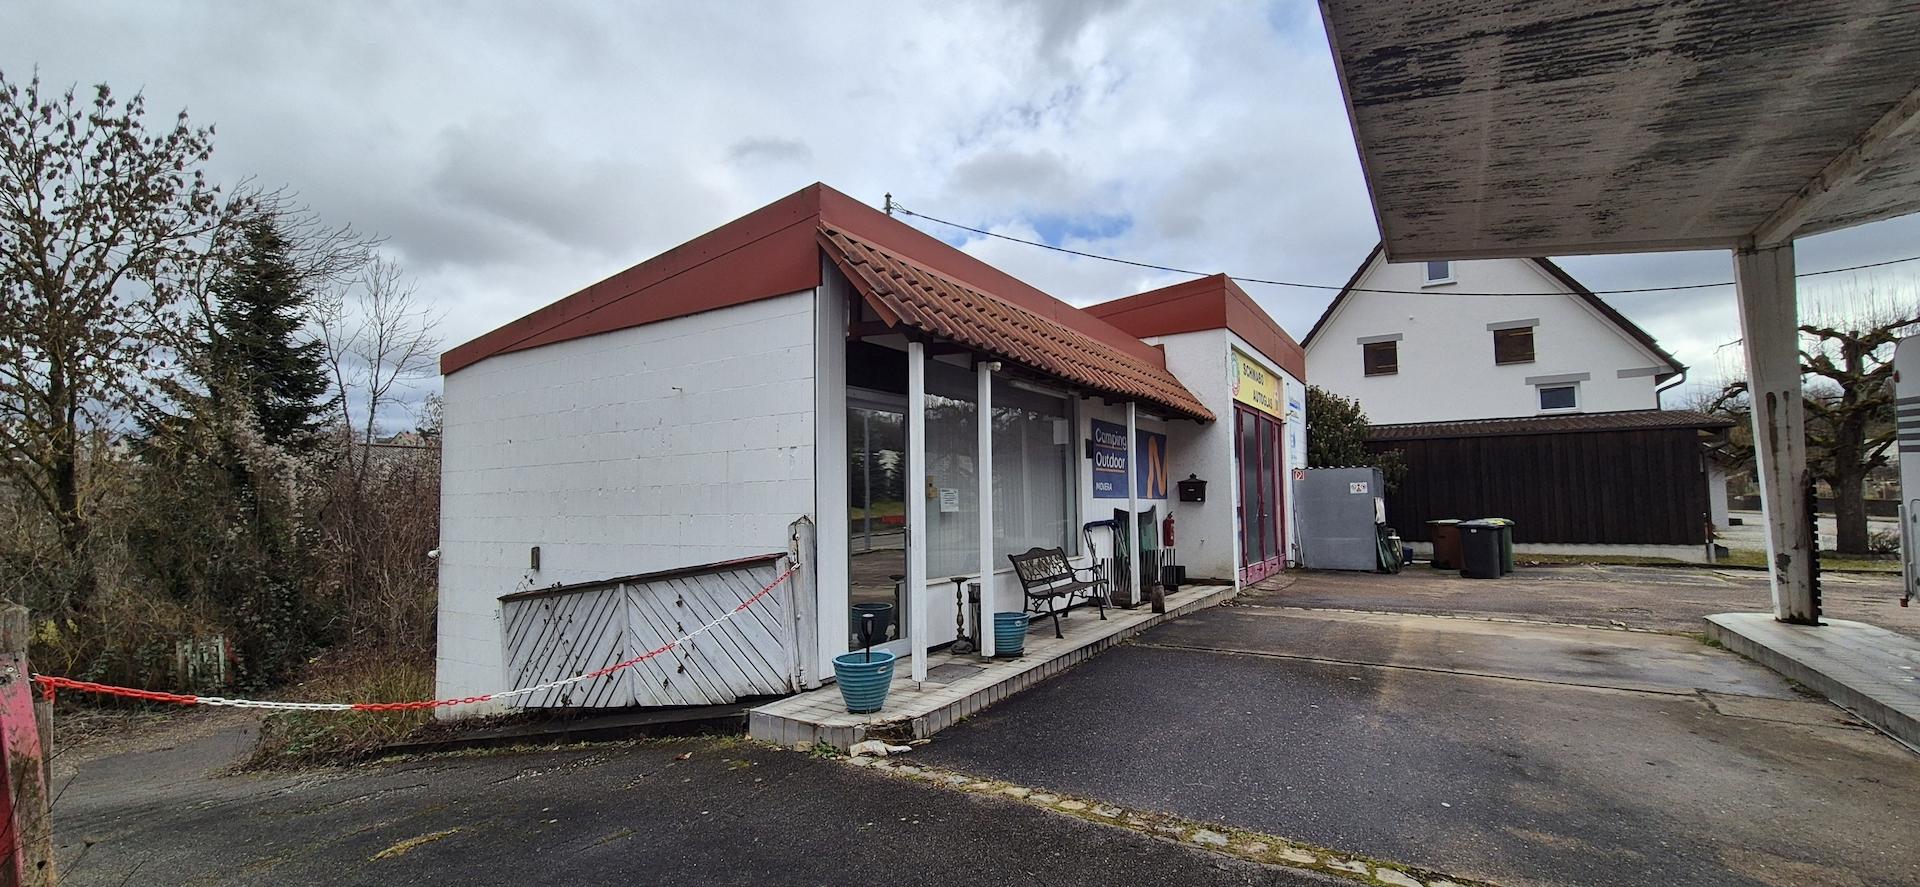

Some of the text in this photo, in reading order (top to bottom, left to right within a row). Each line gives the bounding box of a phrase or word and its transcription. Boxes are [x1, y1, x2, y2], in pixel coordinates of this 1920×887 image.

[1253, 390, 1273, 409] AUTOGLAS
[1095, 428, 1127, 451] Camping
[1096, 451, 1125, 469] Outdoor
